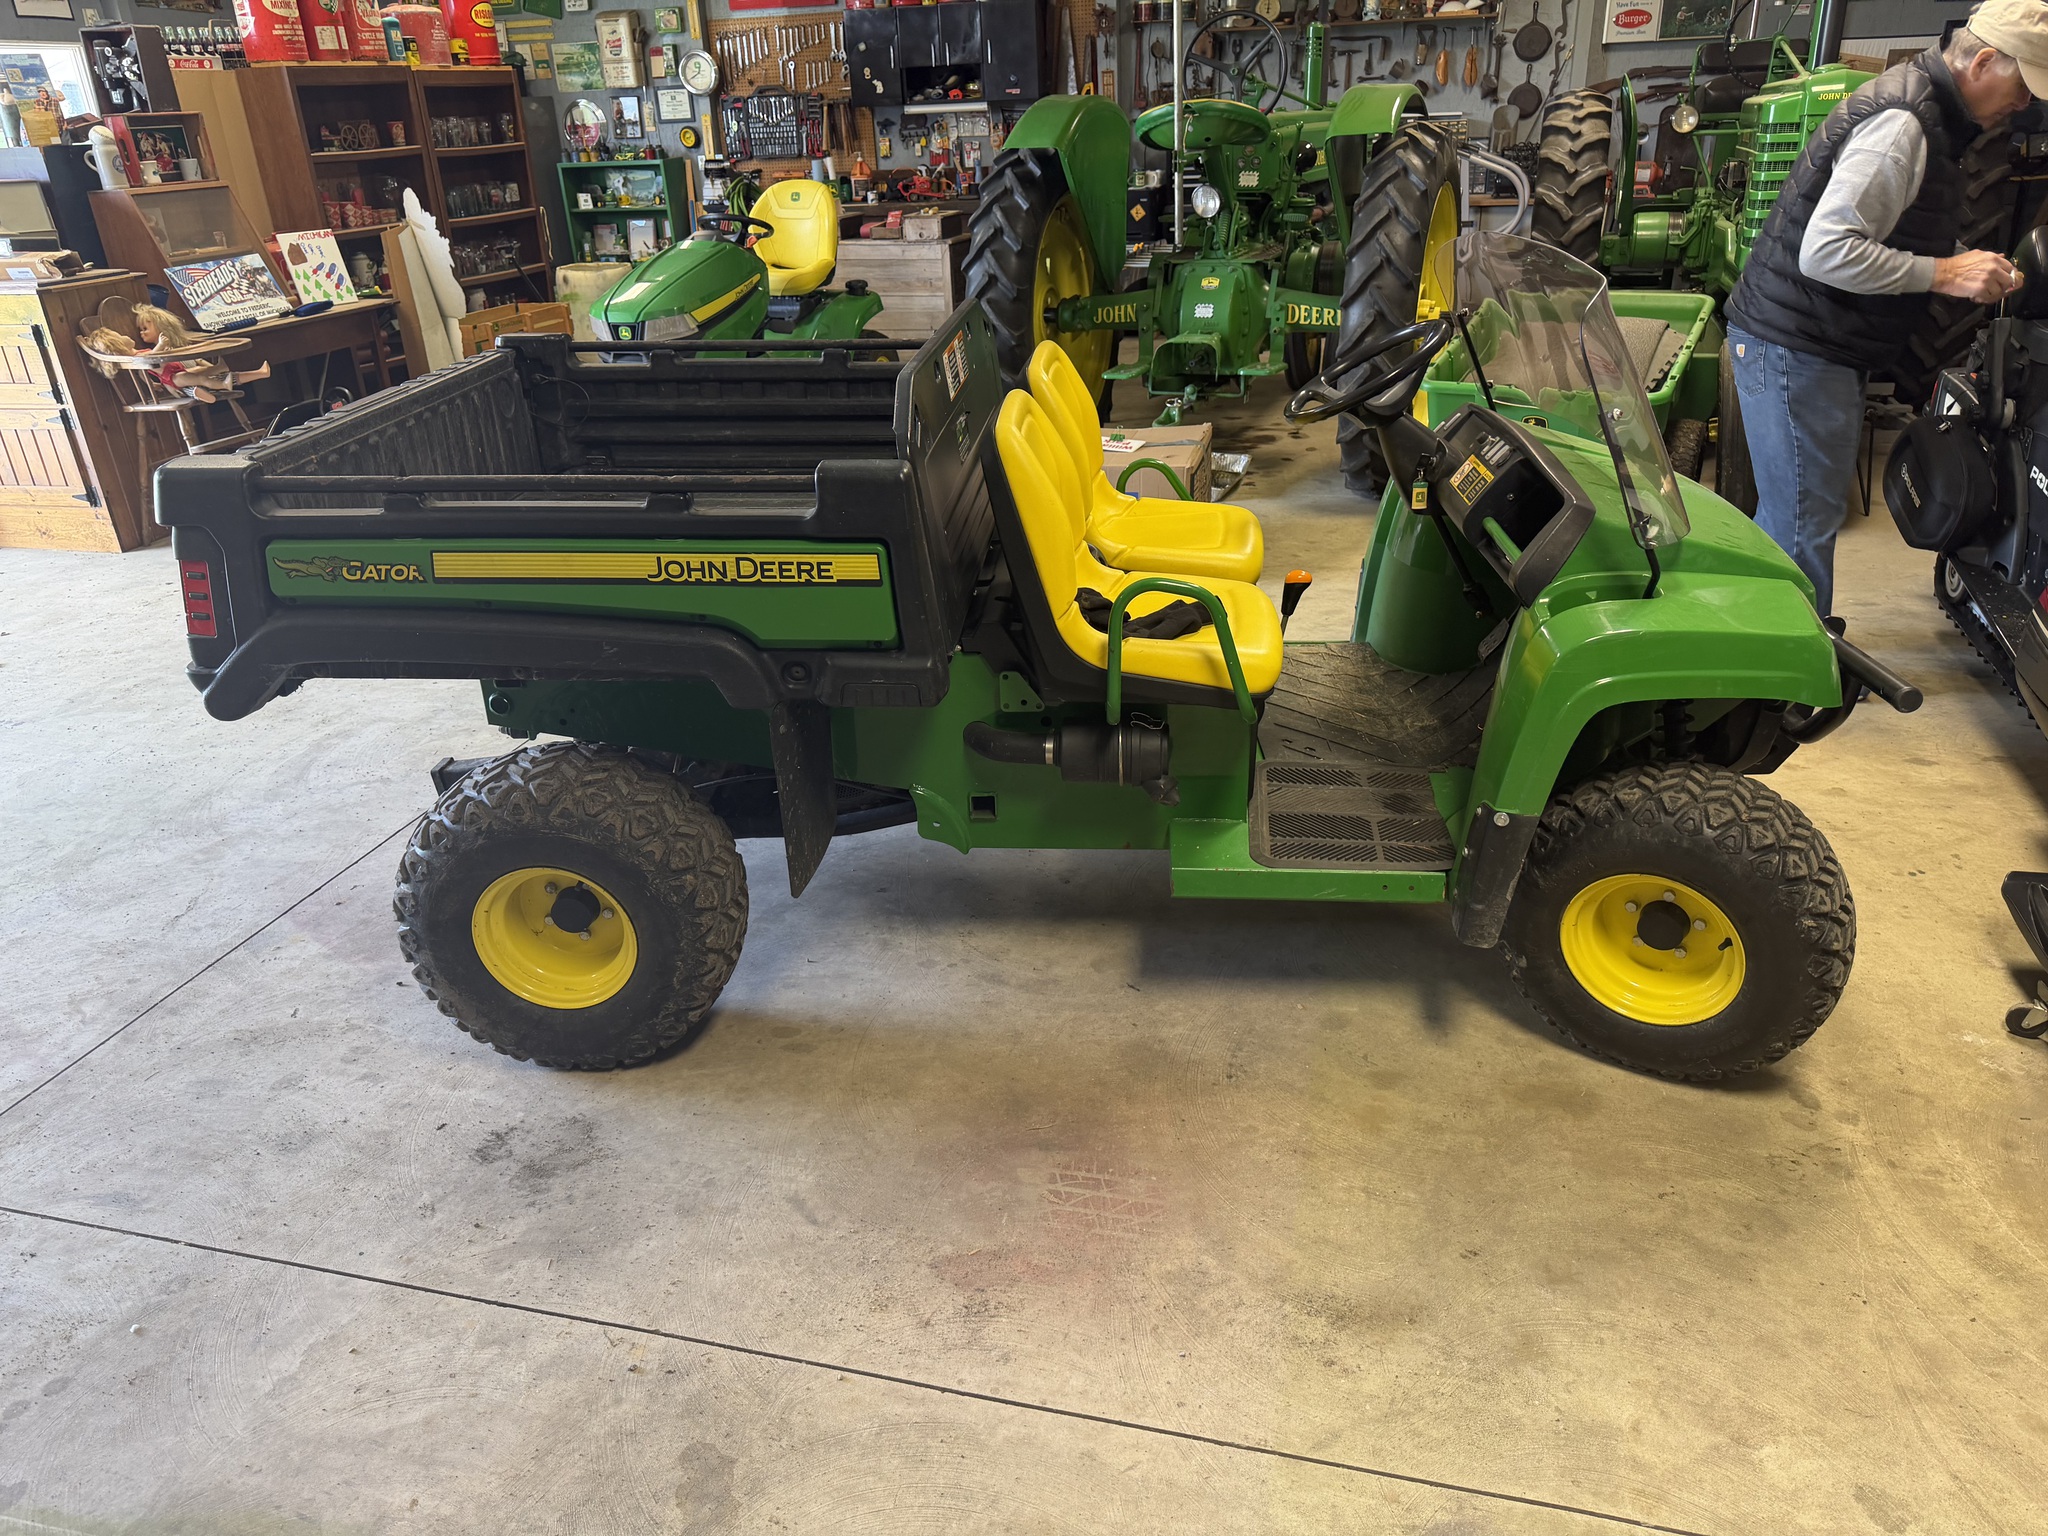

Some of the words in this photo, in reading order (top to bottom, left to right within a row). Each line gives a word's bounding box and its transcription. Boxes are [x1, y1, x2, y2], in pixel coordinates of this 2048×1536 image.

[1618, 14, 1648, 25] Burger
[1818, 93, 1841, 101] JOHN
[298, 231, 334, 241] MICHIGAN
[215, 308, 241, 319] WELCOME
[1093, 303, 1138, 324] JOHN
[1904, 472, 1921, 509] POLARIS
[2029, 465, 2048, 498] POL
[341, 561, 425, 582] GATOR
[647, 556, 730, 583] JOHN
[734, 557, 838, 583] DEERE
